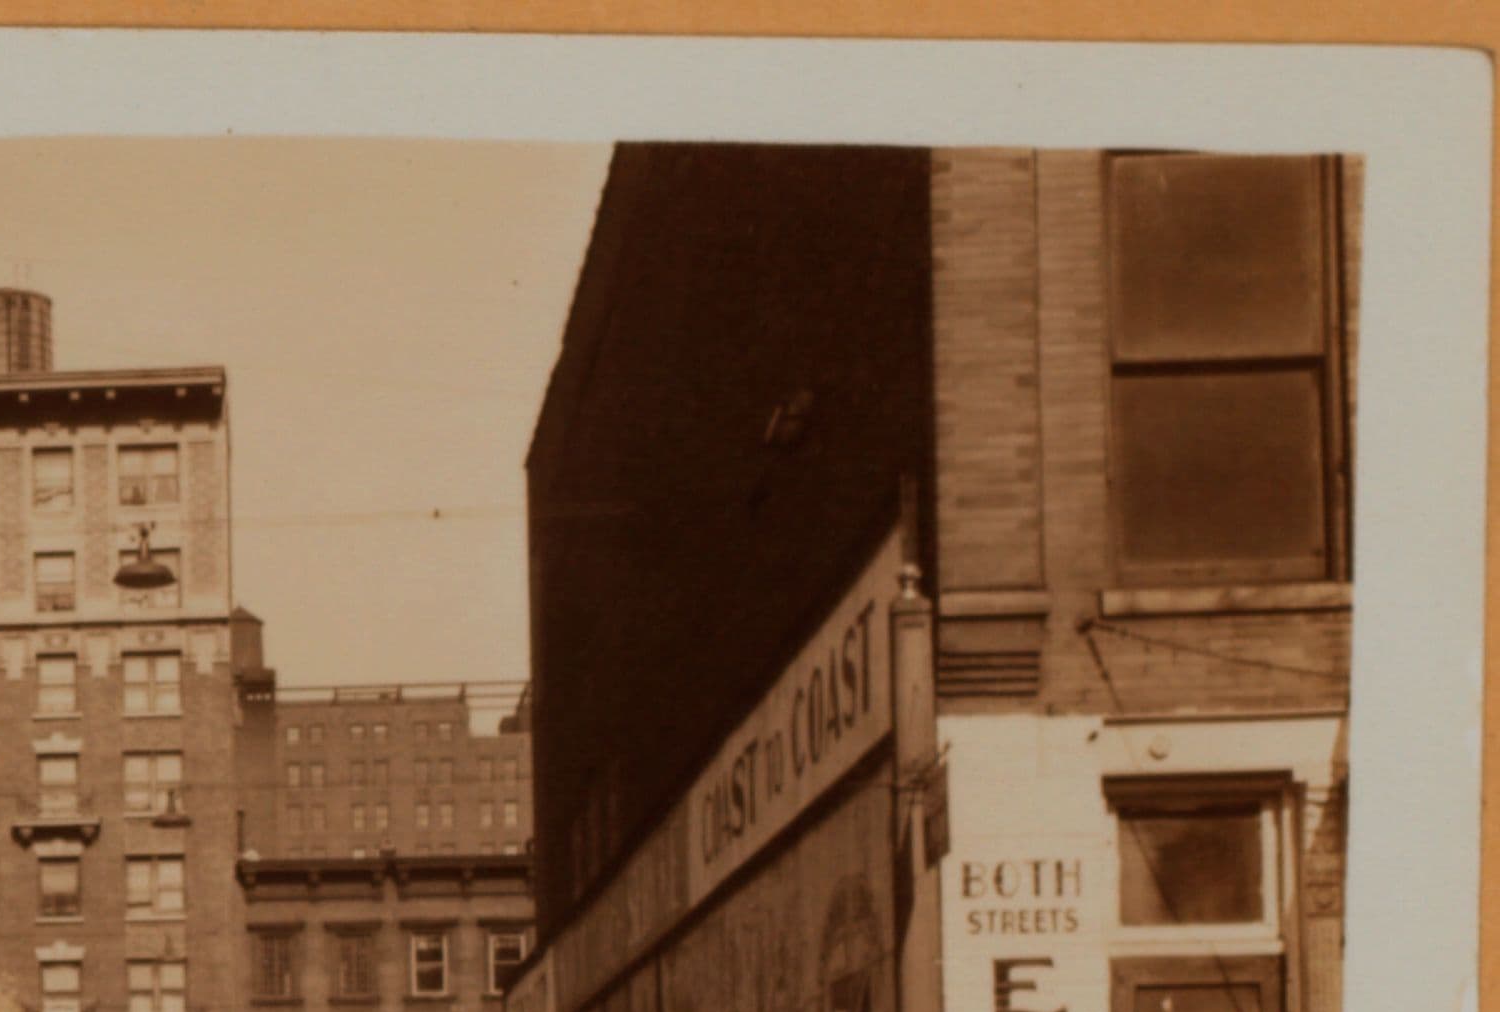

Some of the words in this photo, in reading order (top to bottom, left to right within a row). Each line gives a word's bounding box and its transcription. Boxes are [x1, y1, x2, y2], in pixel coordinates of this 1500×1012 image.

[701, 740, 758, 864] COAST
[790, 598, 875, 779] COAST
[959, 857, 1083, 901] BOTH
[965, 907, 1080, 936] STREETS
